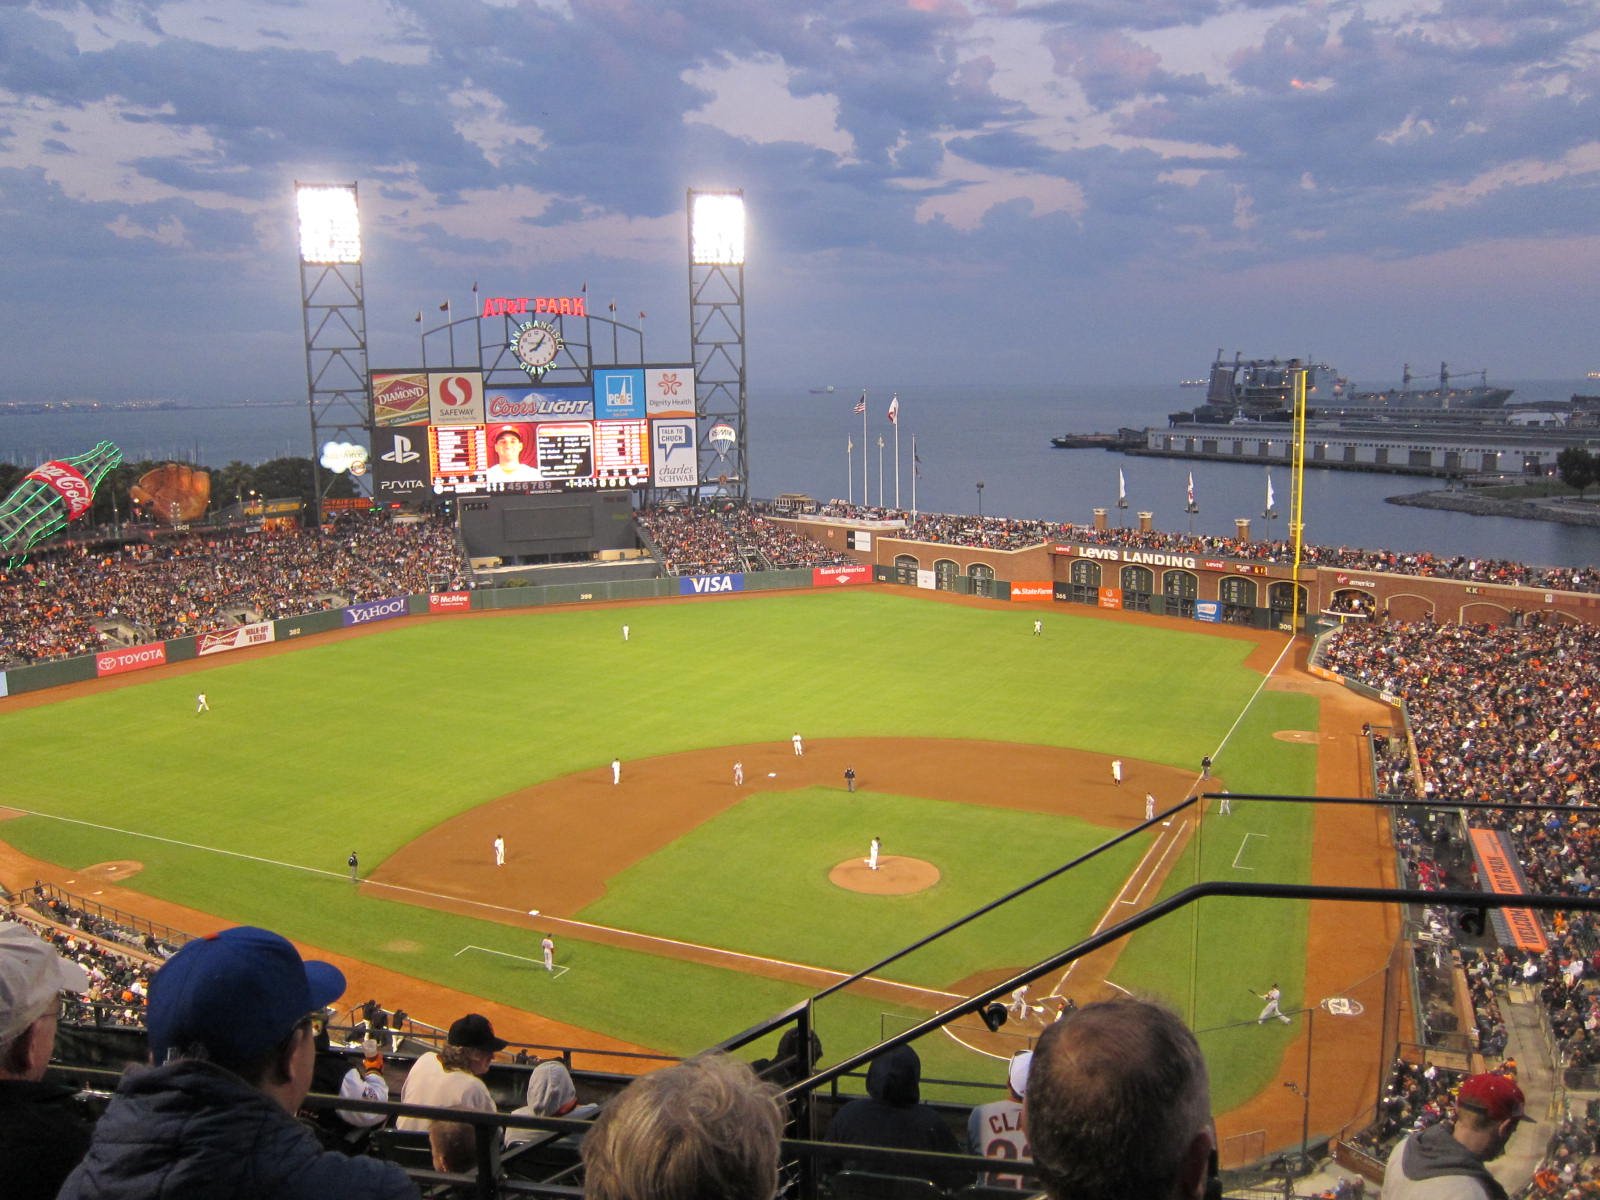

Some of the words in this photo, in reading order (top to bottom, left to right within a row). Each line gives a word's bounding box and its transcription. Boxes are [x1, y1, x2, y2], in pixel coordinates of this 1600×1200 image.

[483, 298, 528, 318] AT&T
[535, 298, 585, 317] PARK
[510, 330, 521, 351] SAN
[520, 320, 564, 350] FRANCISCO
[520, 360, 557, 375] GIANTS
[378, 387, 424, 405] DIAMOND
[439, 409, 474, 417] SAFEWAY
[490, 396, 537, 417] Coors
[537, 400, 589, 415] LIGHT
[659, 464, 693, 475] charles
[1123, 551, 1196, 569] LANDING
[689, 576, 733, 593] VISA
[118, 648, 164, 666] TOYOTA
